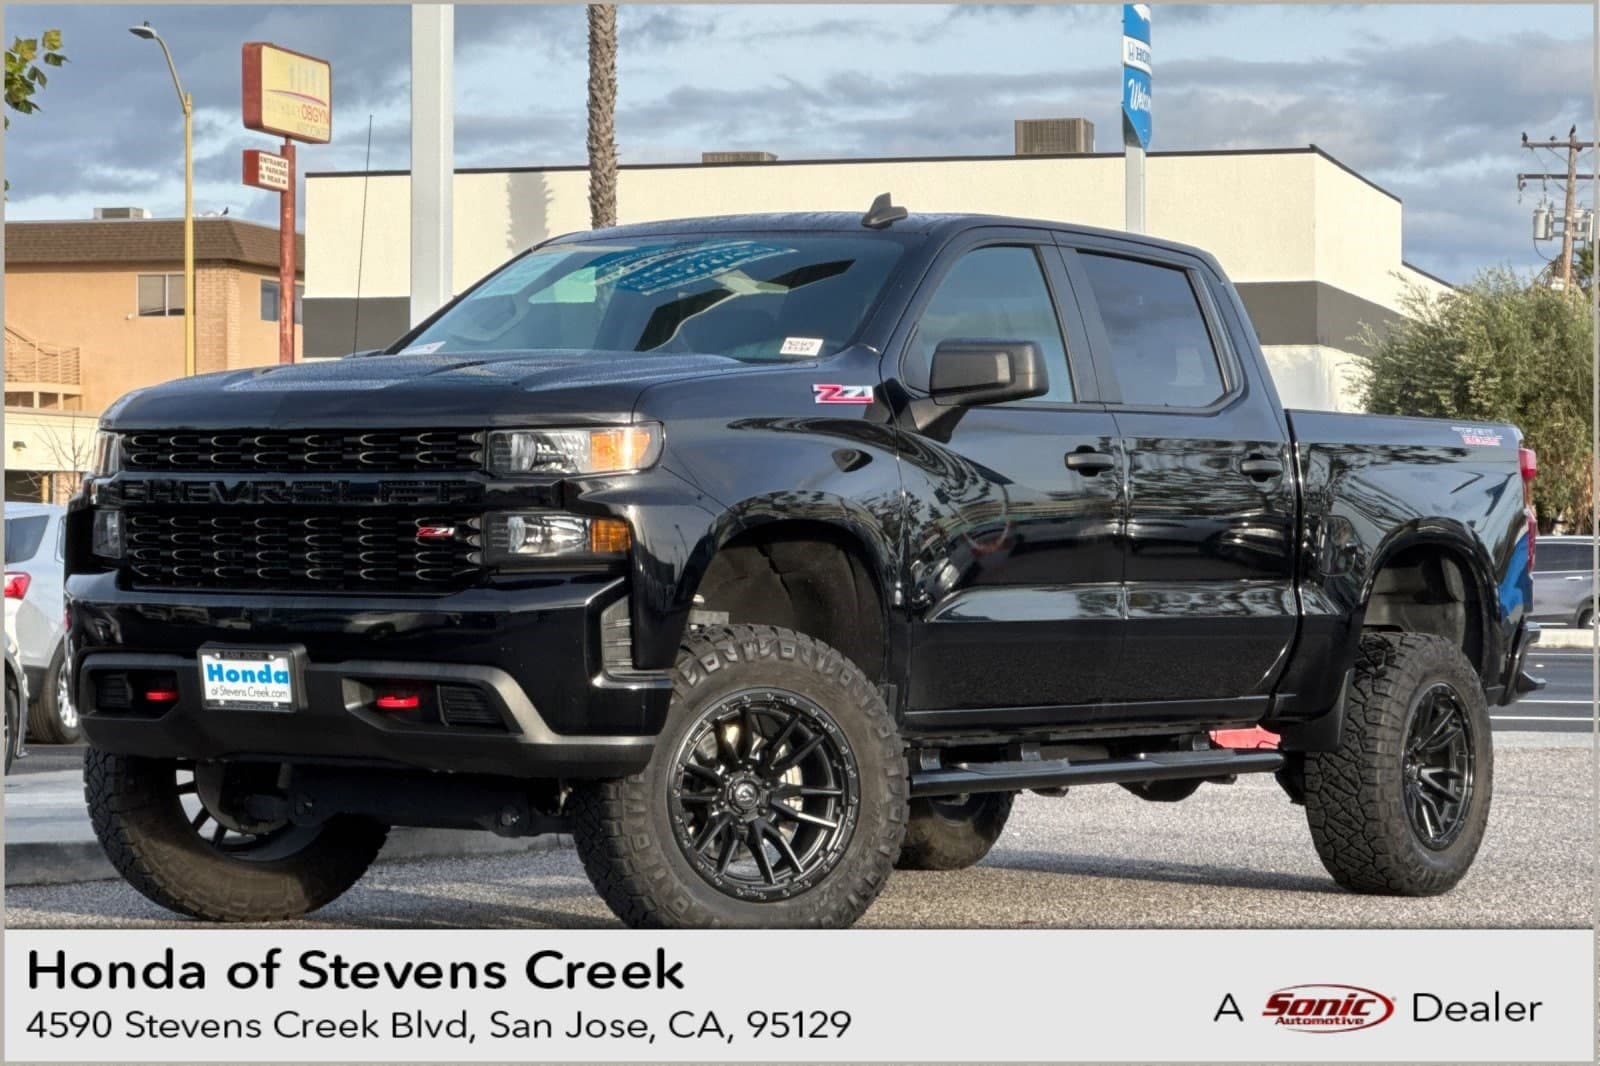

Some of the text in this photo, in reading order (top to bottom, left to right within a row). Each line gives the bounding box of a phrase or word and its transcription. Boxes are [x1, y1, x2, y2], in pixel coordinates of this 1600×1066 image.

[302, 103, 329, 125] OBGYN
[813, 384, 874, 404] Z71
[206, 663, 289, 684] Honda
